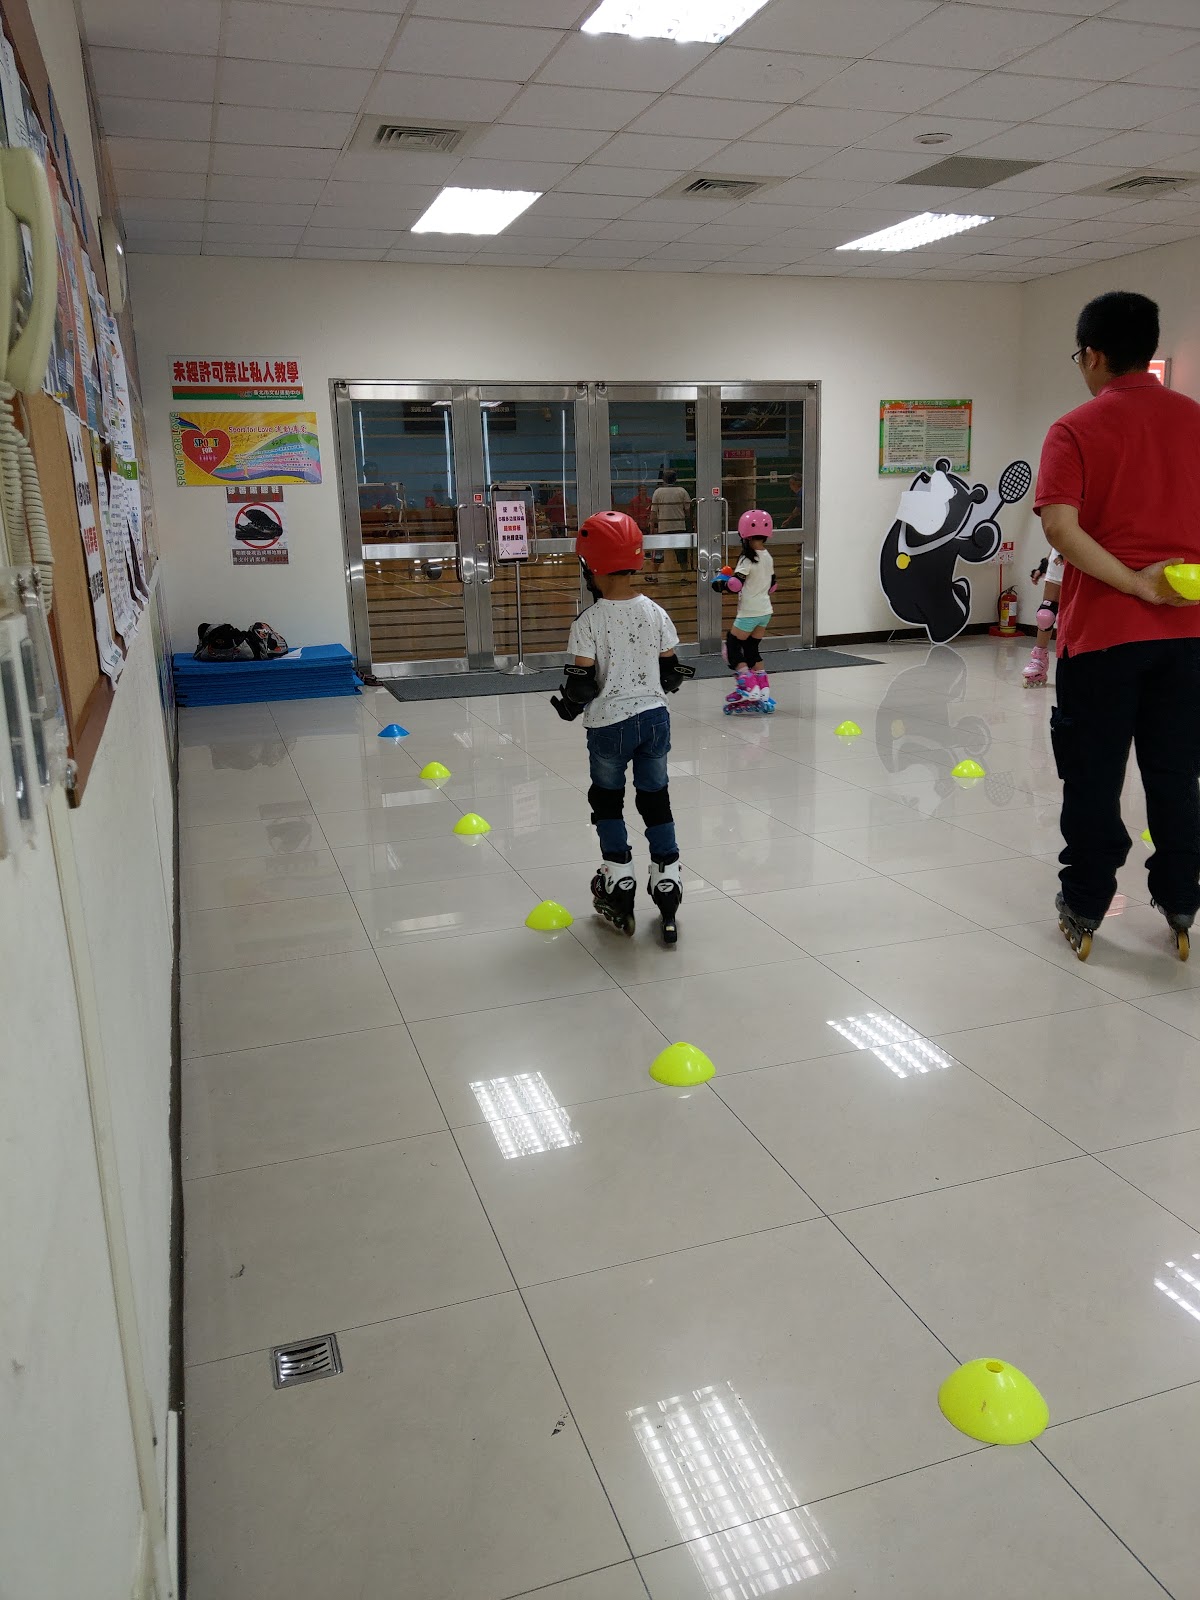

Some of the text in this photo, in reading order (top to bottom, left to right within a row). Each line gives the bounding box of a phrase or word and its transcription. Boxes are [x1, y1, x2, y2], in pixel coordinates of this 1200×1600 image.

[173, 360, 299, 383] 未經許可禁止私人教學
[194, 438, 219, 448] SPORT
